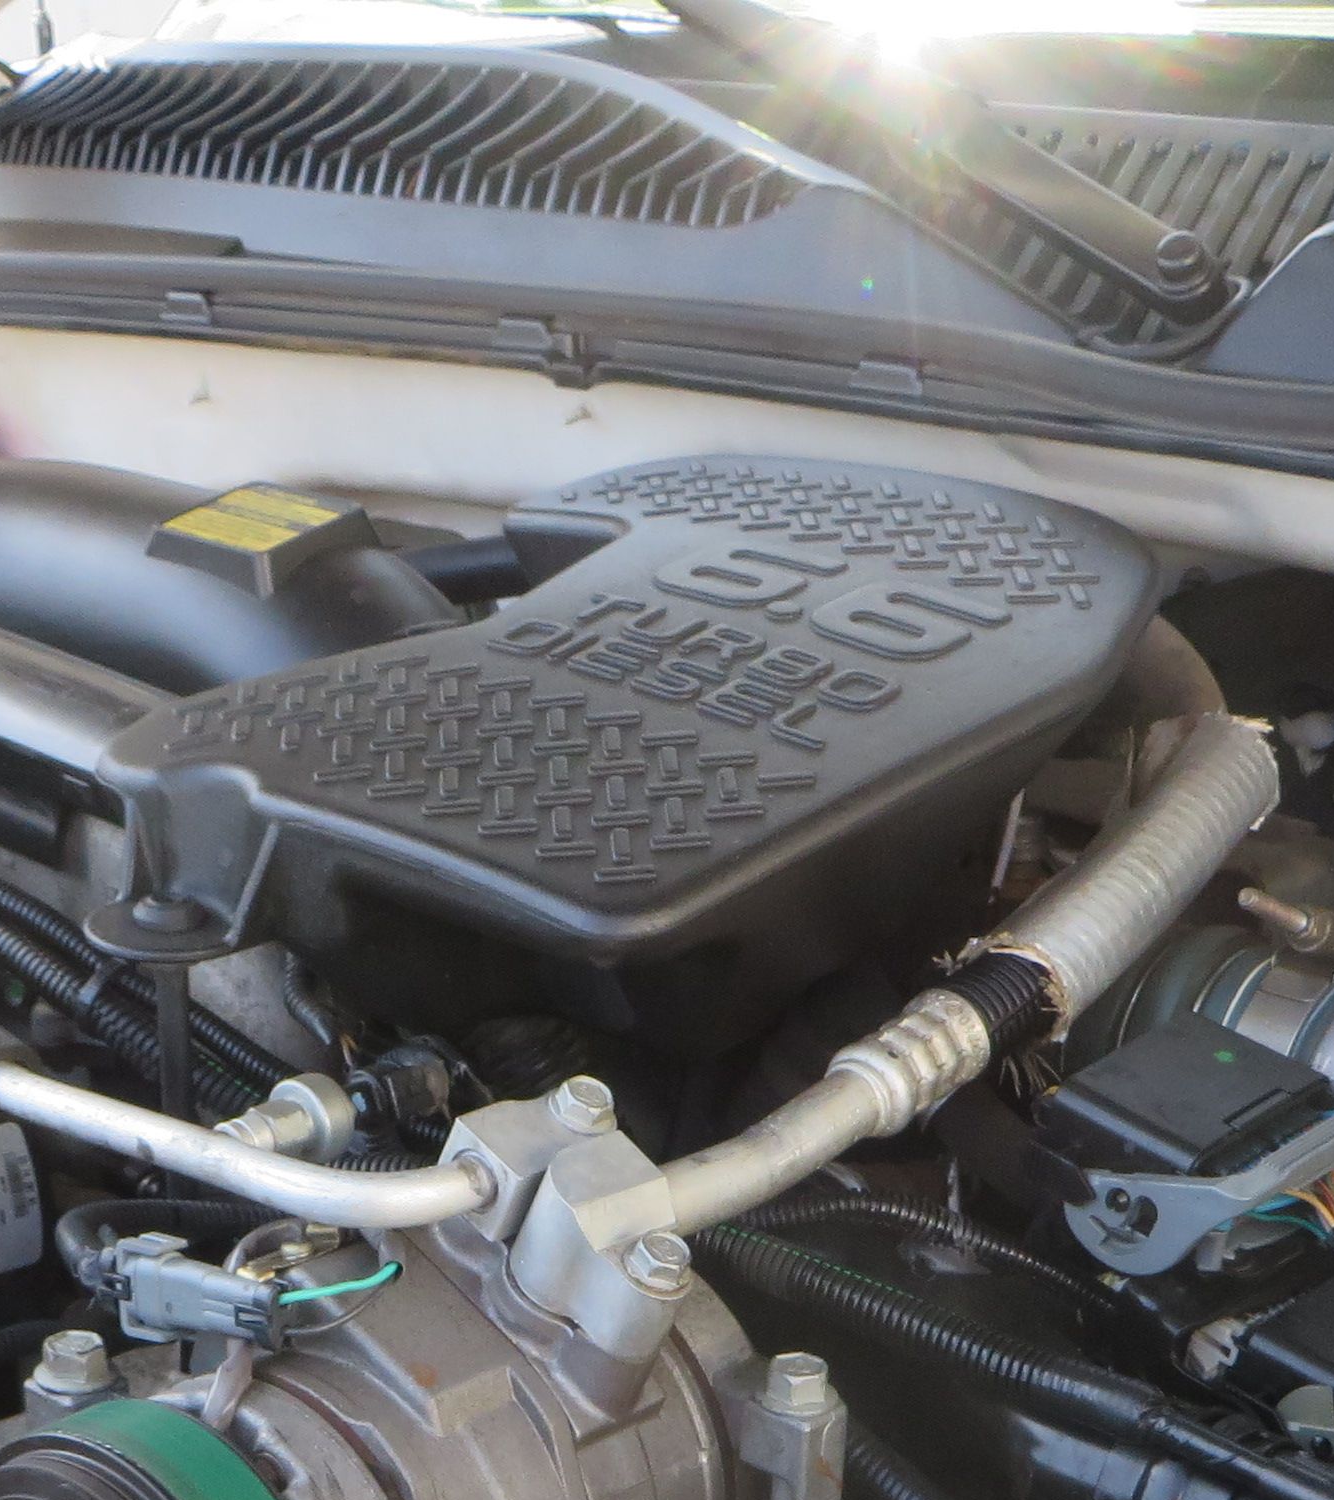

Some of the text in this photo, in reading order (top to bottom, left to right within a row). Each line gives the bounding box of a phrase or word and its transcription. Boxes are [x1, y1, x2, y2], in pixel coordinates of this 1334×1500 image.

[575, 593, 903, 713] TURBO
[653, 547, 1013, 661] 6.6
[486, 617, 825, 750] DIESEL
